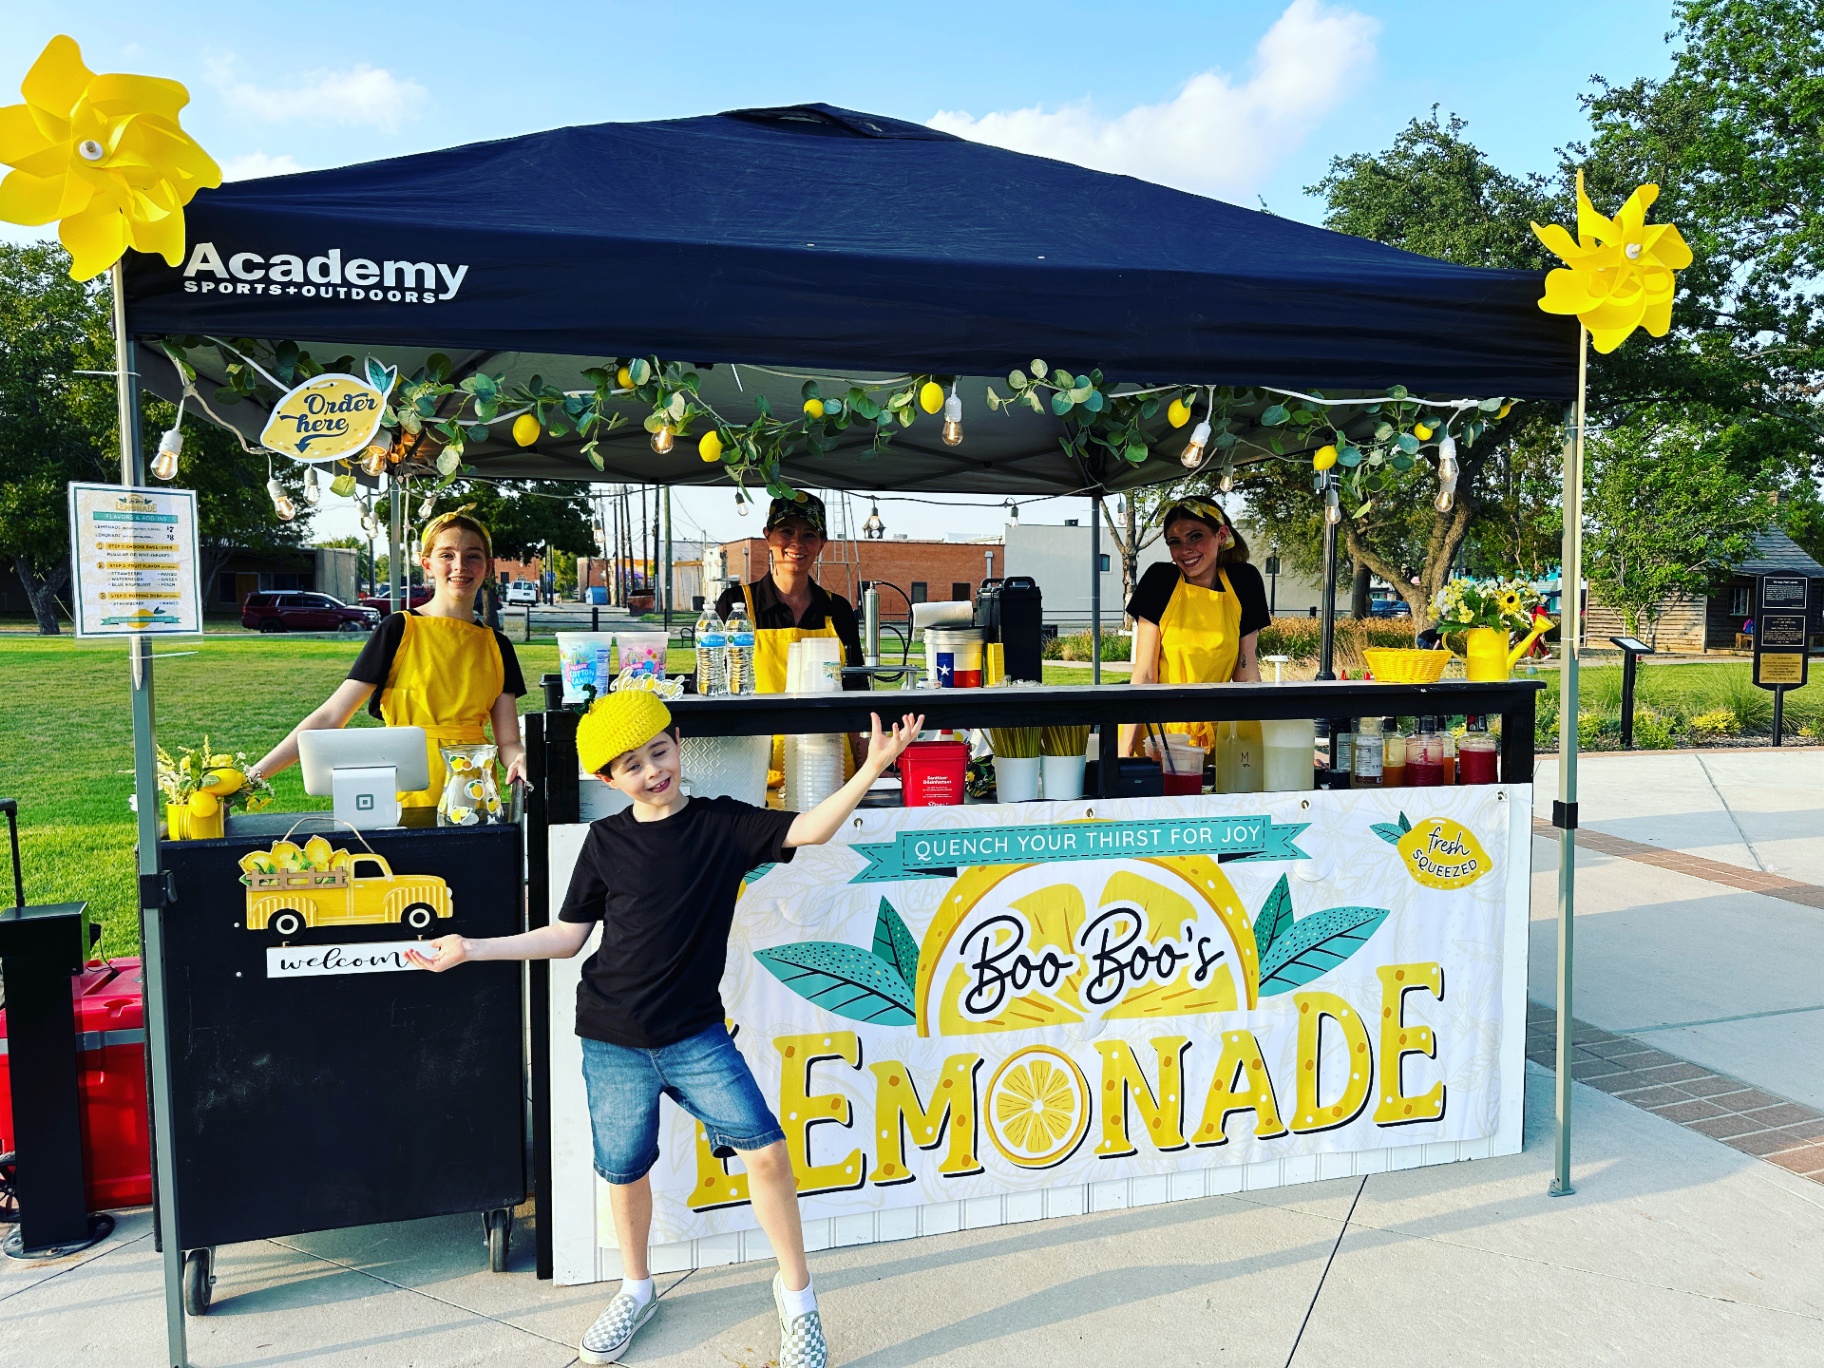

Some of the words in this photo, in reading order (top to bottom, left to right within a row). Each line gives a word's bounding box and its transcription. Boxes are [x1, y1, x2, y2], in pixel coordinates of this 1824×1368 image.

[183, 242, 469, 300] Academy
[184, 280, 436, 304] SPORTS+OUTDOORS
[303, 392, 378, 416] Order
[279, 413, 350, 434] here
[569, 669, 595, 678] COTTON
[571, 676, 594, 685] CANDY
[914, 837, 1008, 861] QUENCH
[1017, 833, 1077, 852] YOUR
[1086, 829, 1161, 848] THIRST
[1171, 827, 1212, 845] FOR
[1221, 825, 1260, 843] JOY
[1428, 826, 1471, 855] fresh
[1412, 848, 1478, 878] SQUEEZED
[280, 947, 411, 970] welcom
[960, 915, 1073, 1014] Boo
[1081, 907, 1225, 1005] Boo's
